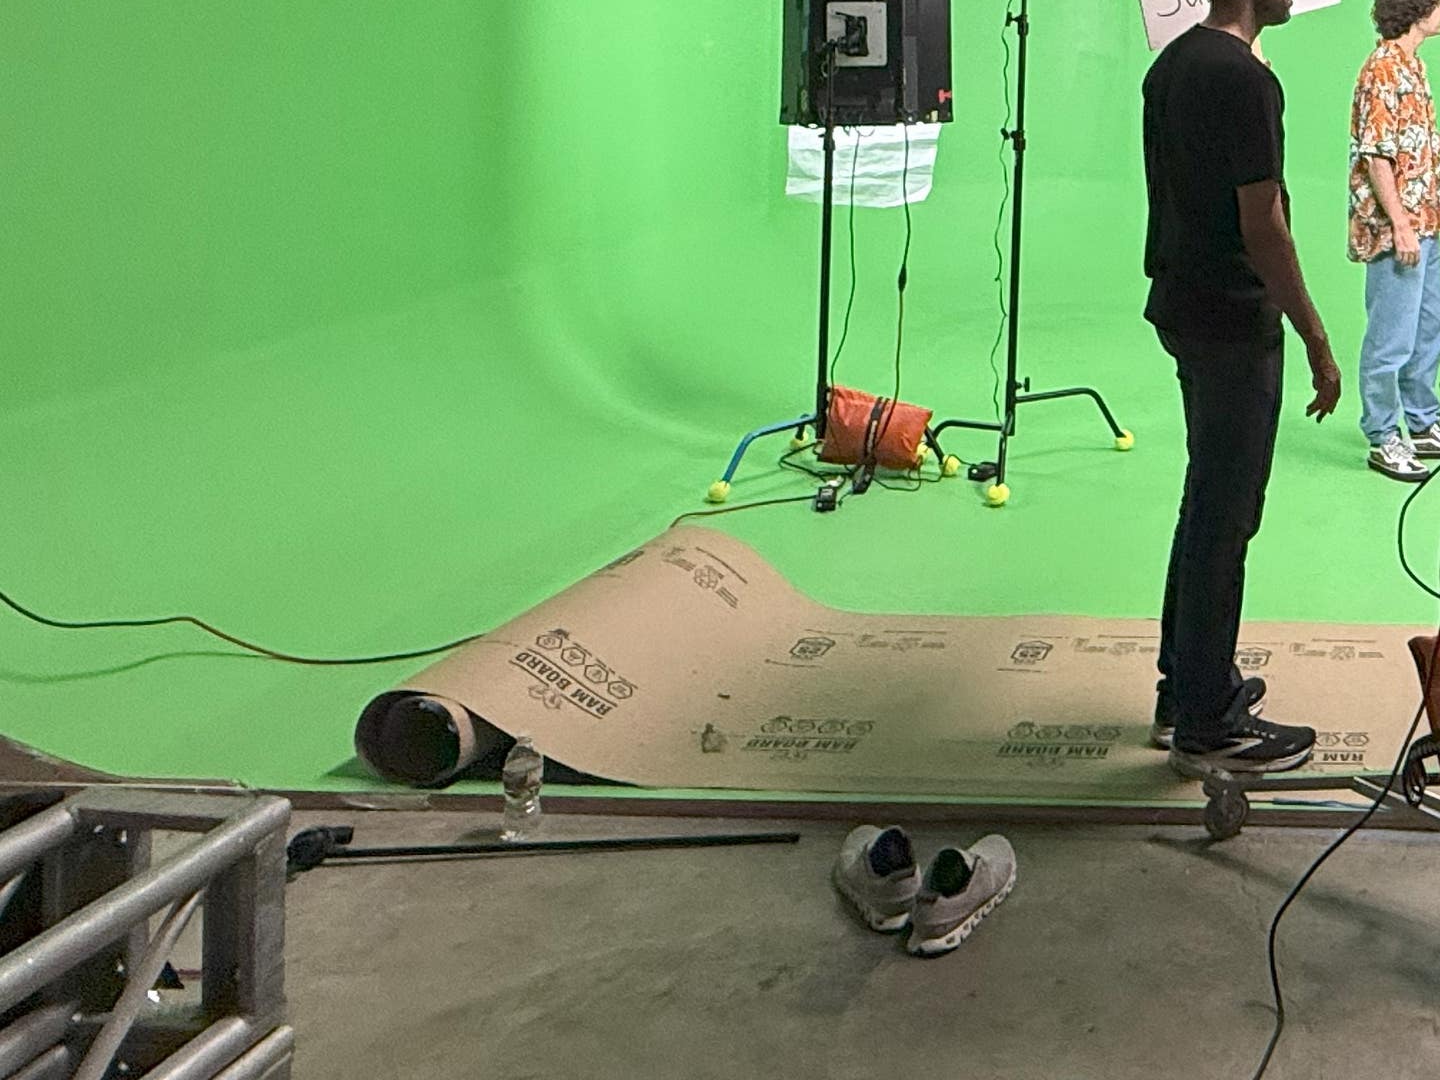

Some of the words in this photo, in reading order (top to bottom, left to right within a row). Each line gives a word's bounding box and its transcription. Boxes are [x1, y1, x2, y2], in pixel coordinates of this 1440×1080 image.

[515, 652, 571, 690] BOARD
[571, 689, 614, 716] RAM
[1322, 752, 1364, 762] RAM
